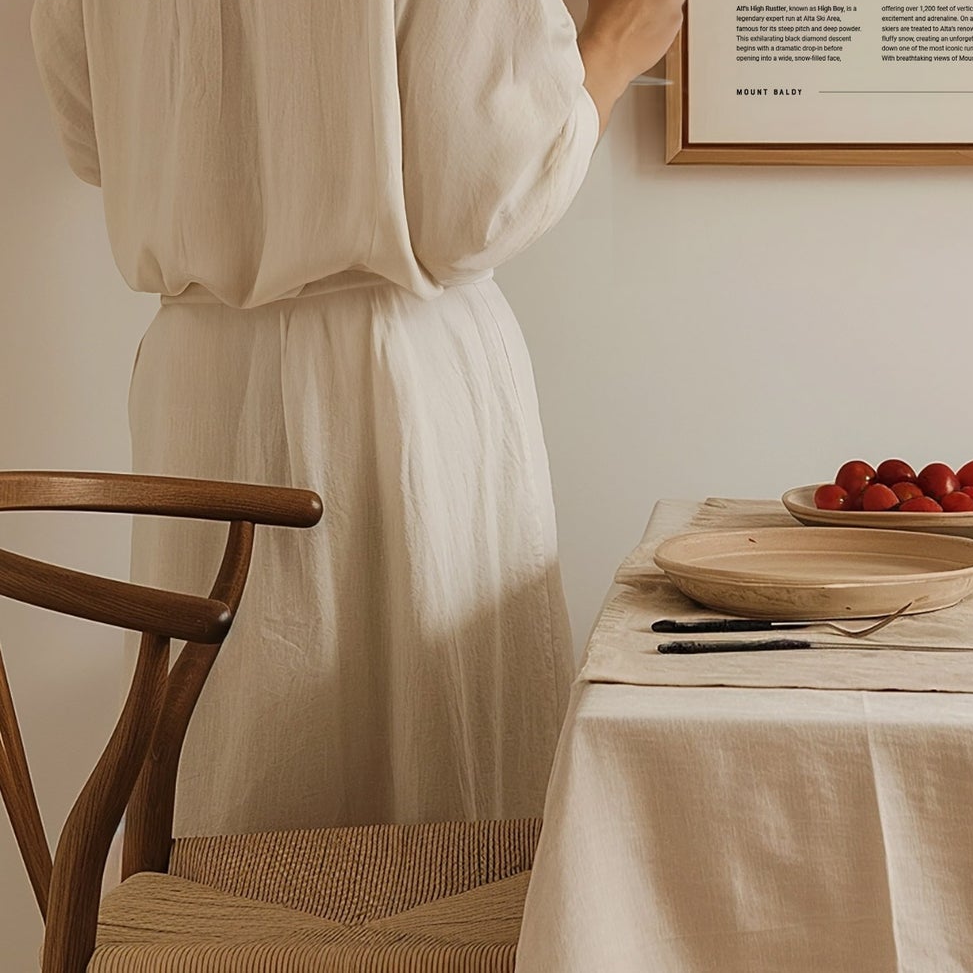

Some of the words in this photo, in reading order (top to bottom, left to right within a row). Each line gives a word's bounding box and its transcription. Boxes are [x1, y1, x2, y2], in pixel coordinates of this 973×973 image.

[750, 4, 765, 14] High
[817, 4, 832, 14] High
[881, 5, 905, 14] offering
[919, 5, 936, 13] 1,200
[736, 15, 766, 23] legendary
[765, 15, 785, 23] expert
[777, 25, 795, 33] steep
[794, 25, 811, 33] pitch
[822, 25, 839, 33] deep
[735, 34, 750, 42] This
[749, 35, 784, 43] exhilarating
[881, 35, 898, 43] fluffy
[915, 35, 940, 43] creating
[736, 45, 756, 53] begins
[801, 45, 823, 53] drop-in
[794, 54, 827, 62] snow-filled
[881, 54, 896, 62] With
[736, 88, 768, 96] MOUNT
[773, 88, 802, 96] BALDY
